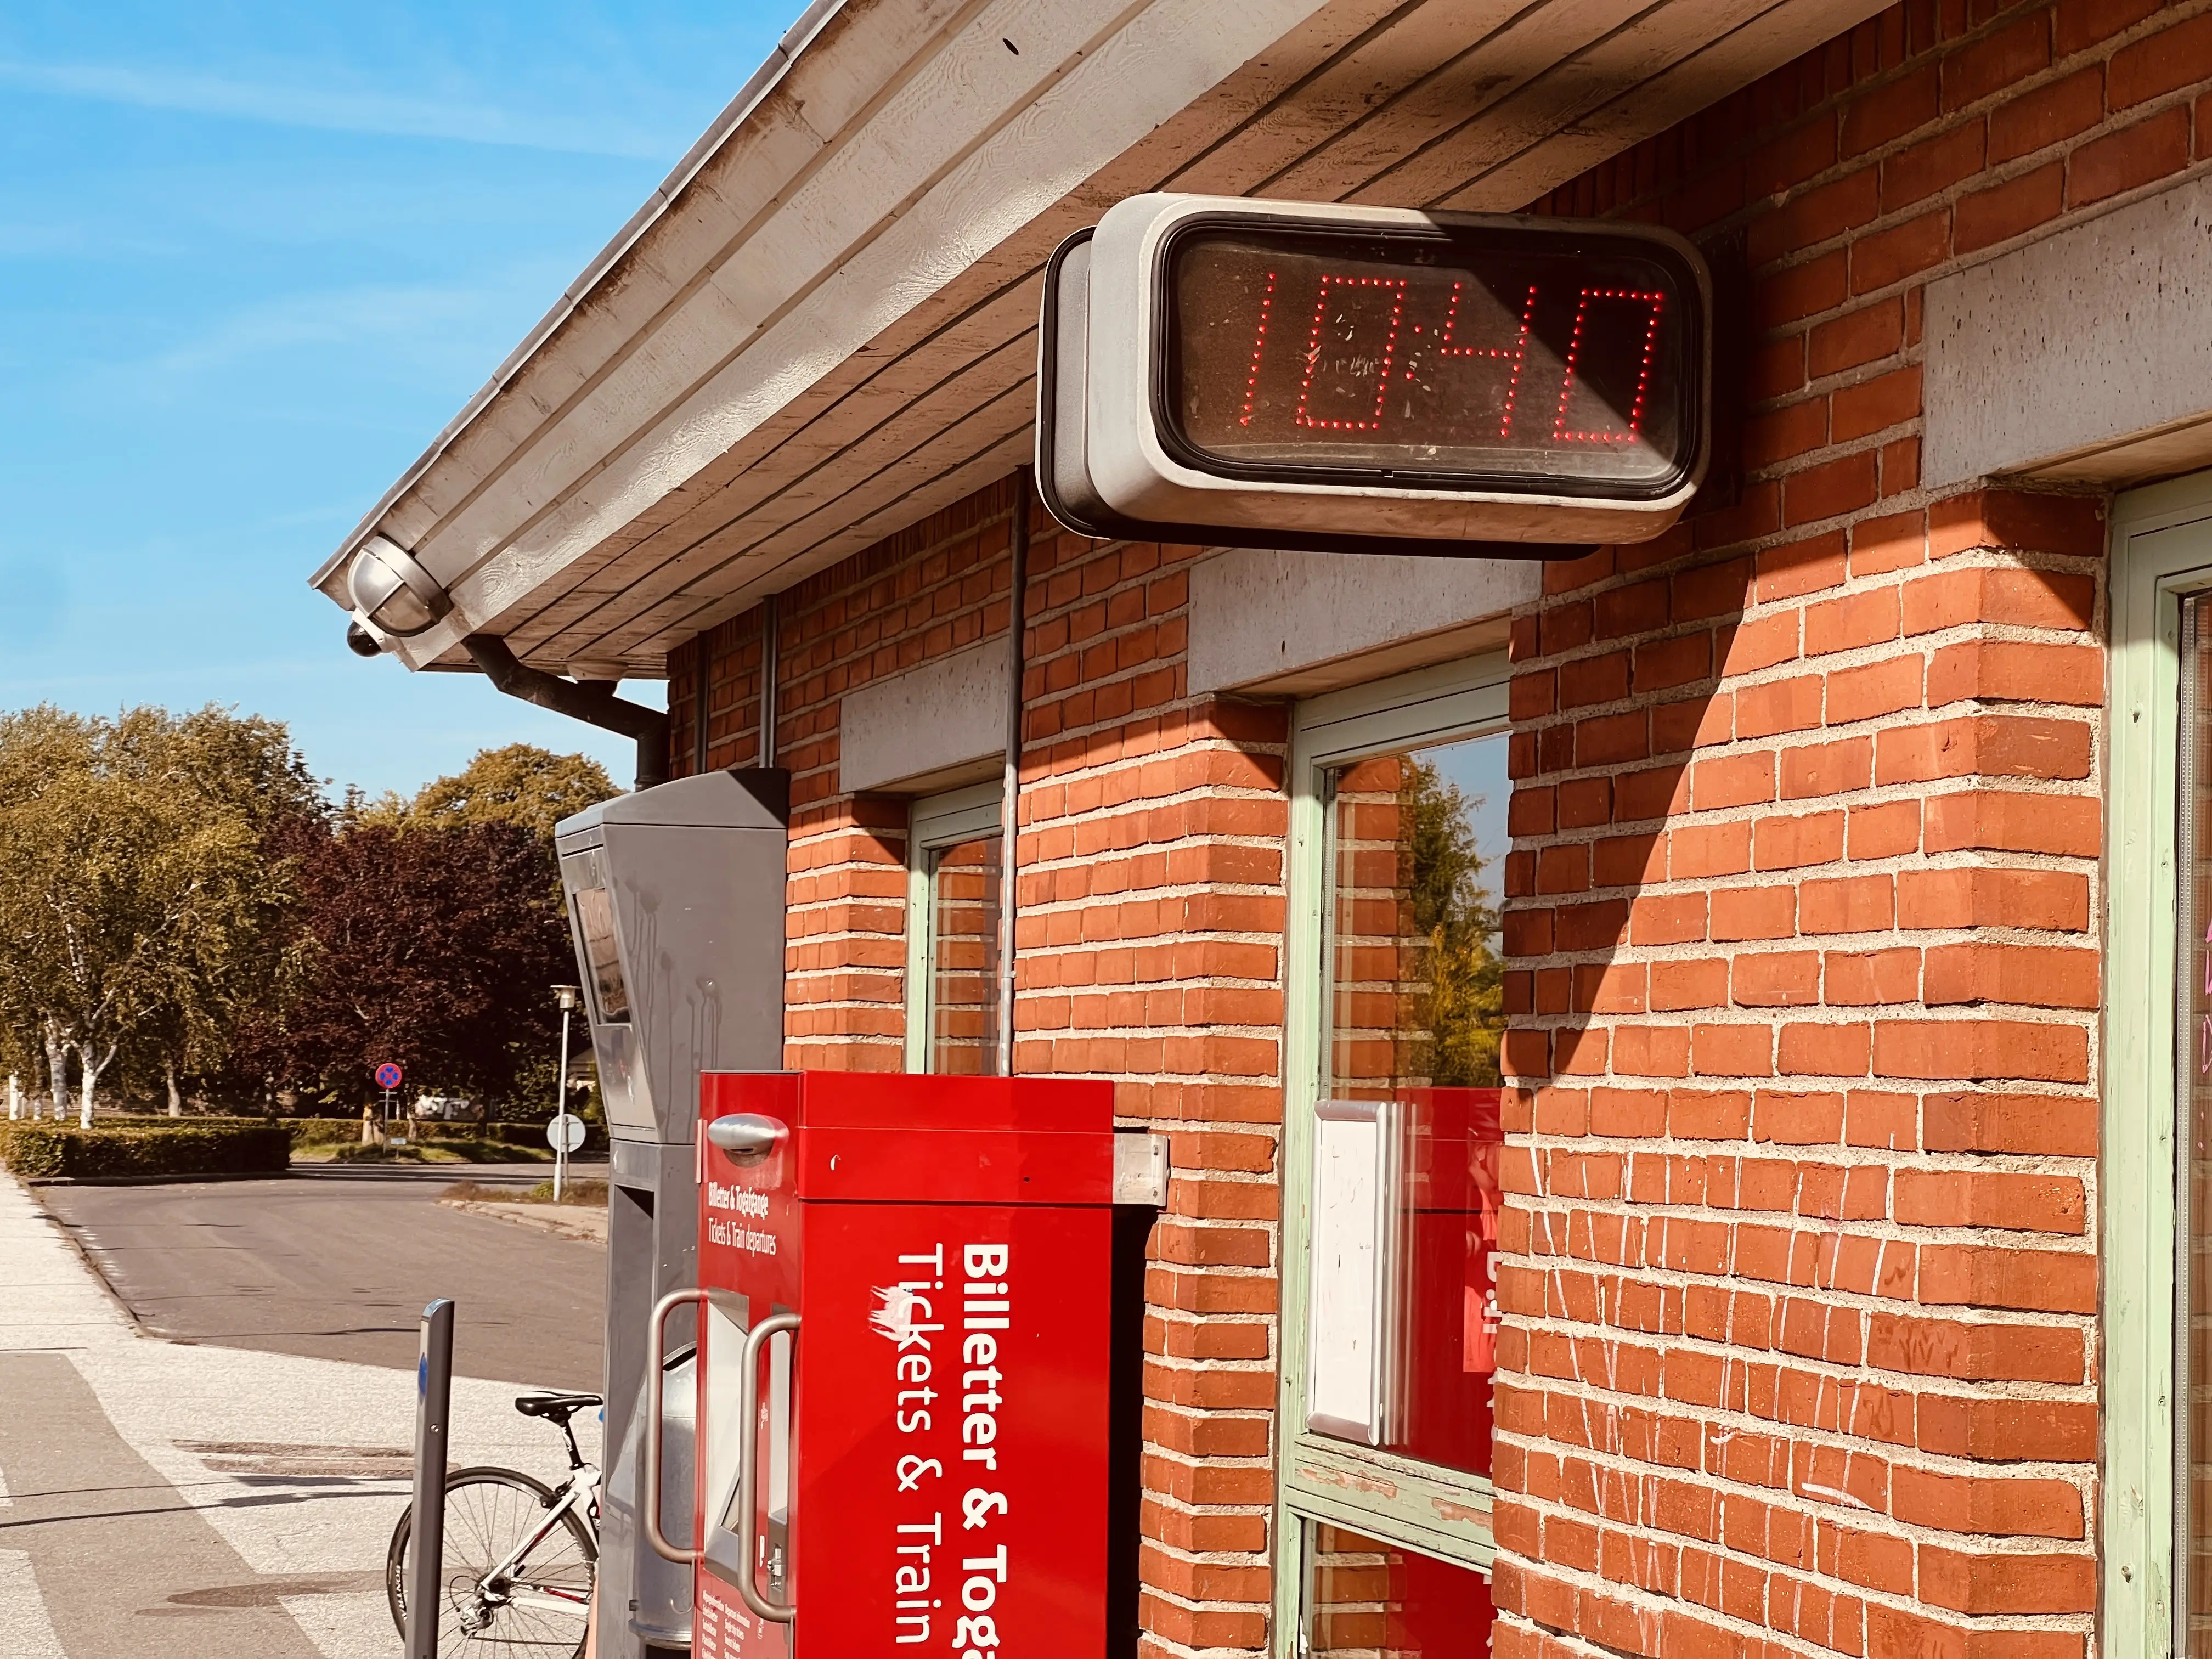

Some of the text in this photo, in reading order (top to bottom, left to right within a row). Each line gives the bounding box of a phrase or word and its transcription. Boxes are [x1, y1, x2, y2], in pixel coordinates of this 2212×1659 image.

[1239, 272, 1663, 443] 10:40
[708, 1217, 776, 1257] Tickets & Train departures
[730, 1184, 735, 1210] &
[963, 1244, 1010, 1471] Billetter
[895, 1242, 945, 1644] Tickets & Train
[962, 1487, 1009, 1531] &
